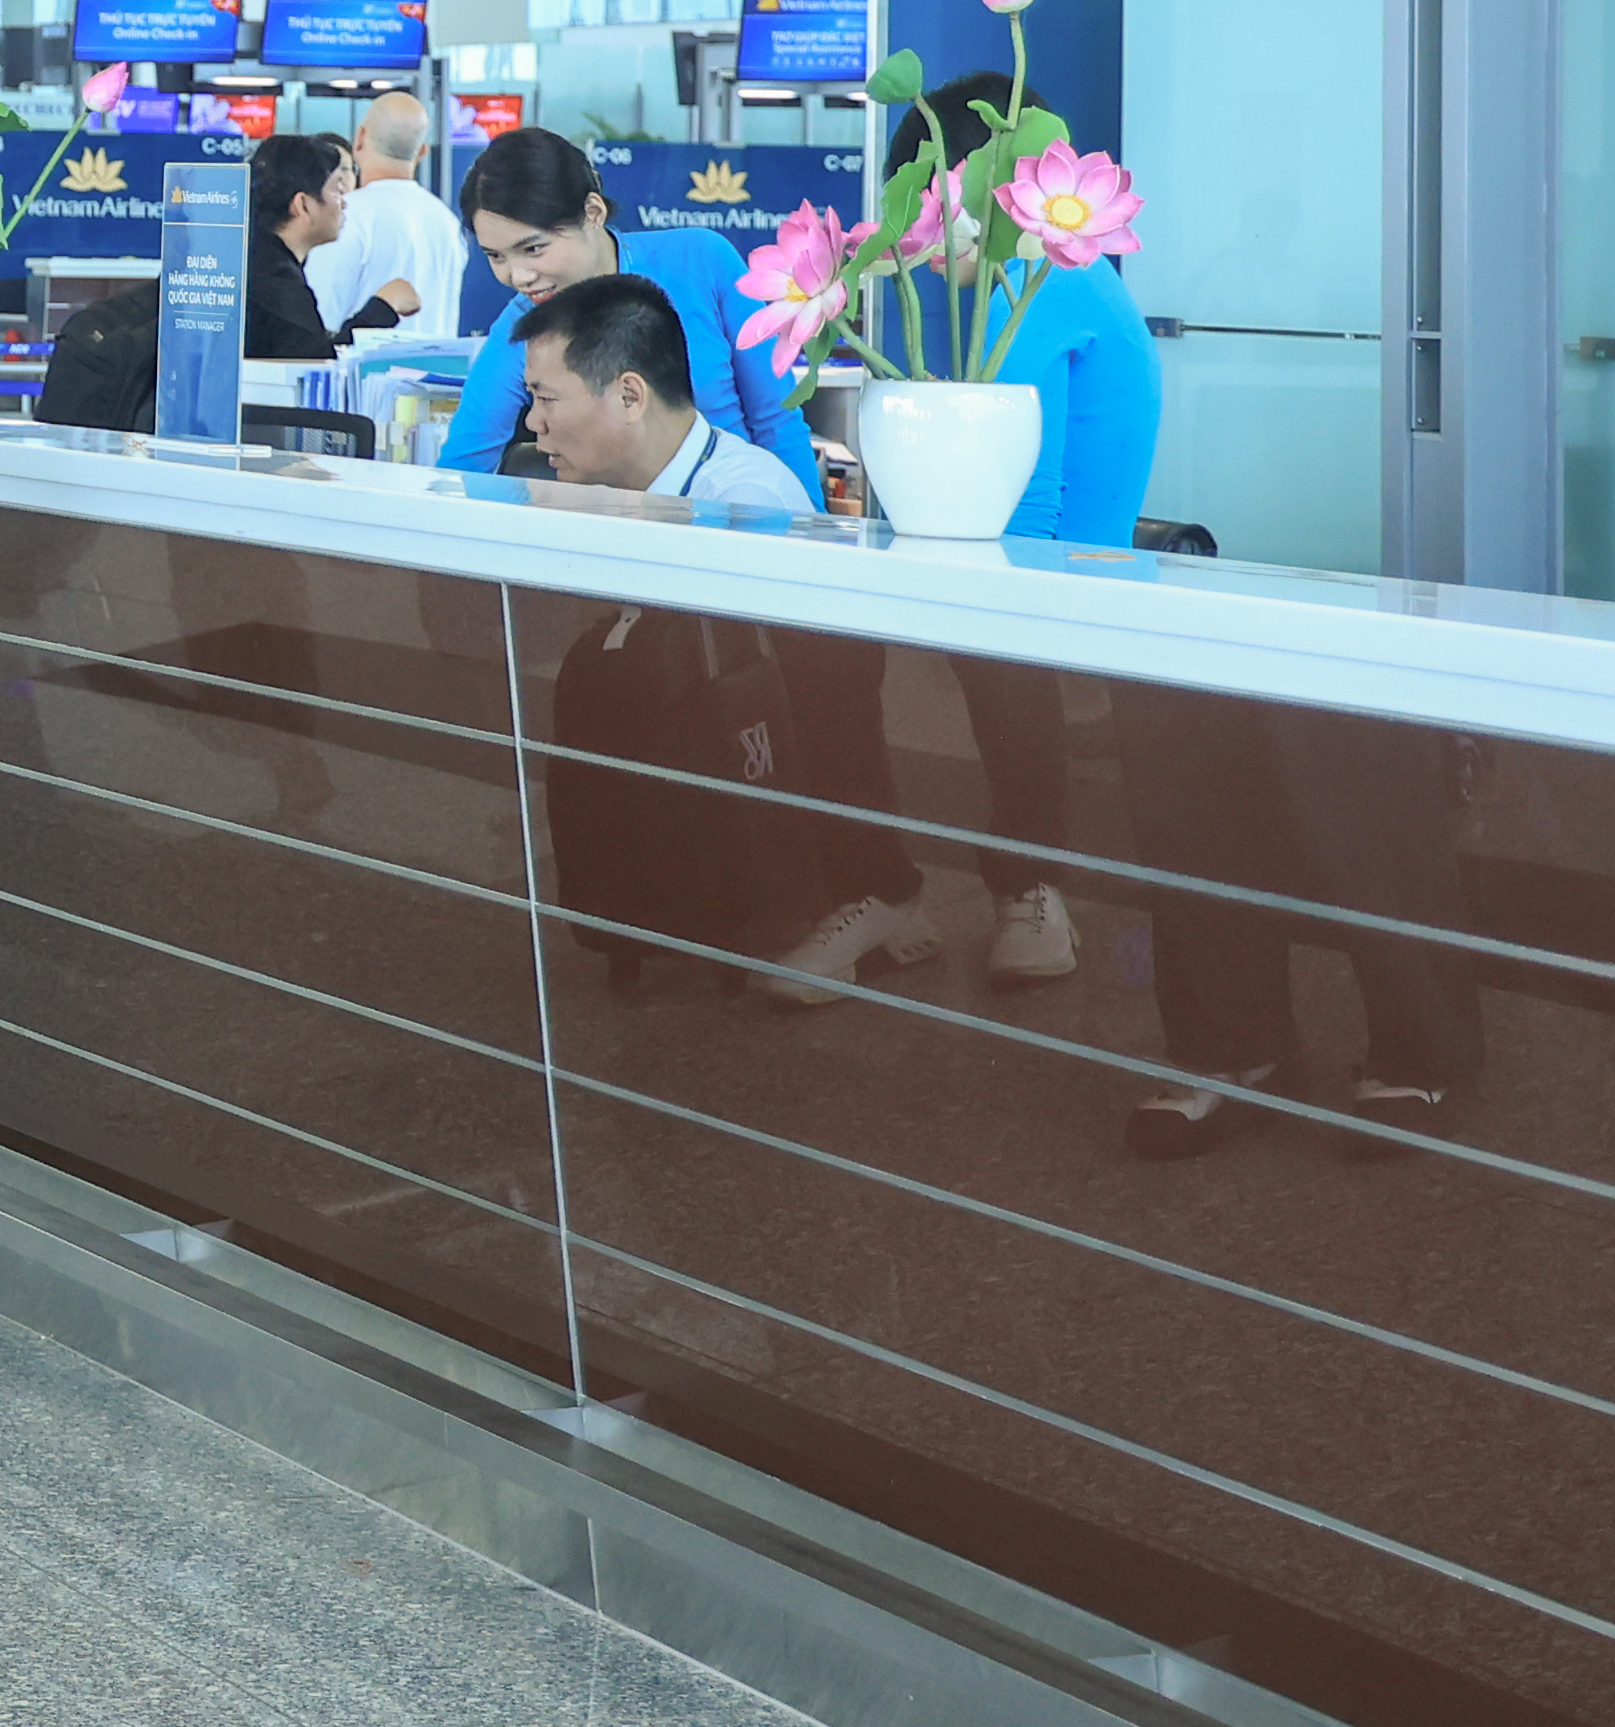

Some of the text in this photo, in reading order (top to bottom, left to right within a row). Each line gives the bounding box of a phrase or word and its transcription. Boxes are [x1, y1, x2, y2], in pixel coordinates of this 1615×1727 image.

[202, 137, 242, 156] C-05
[593, 147, 632, 165] C-06
[101, 197, 164, 218] Airline
[638, 206, 722, 229] Vietnam
[187, 254, 217, 271] ĐẠI DIỆN
[210, 274, 235, 288] KHÔNG
[168, 288, 234, 308] QUỐC GIA VIỆT NAM
[175, 318, 224, 331] STATION MANAGER
